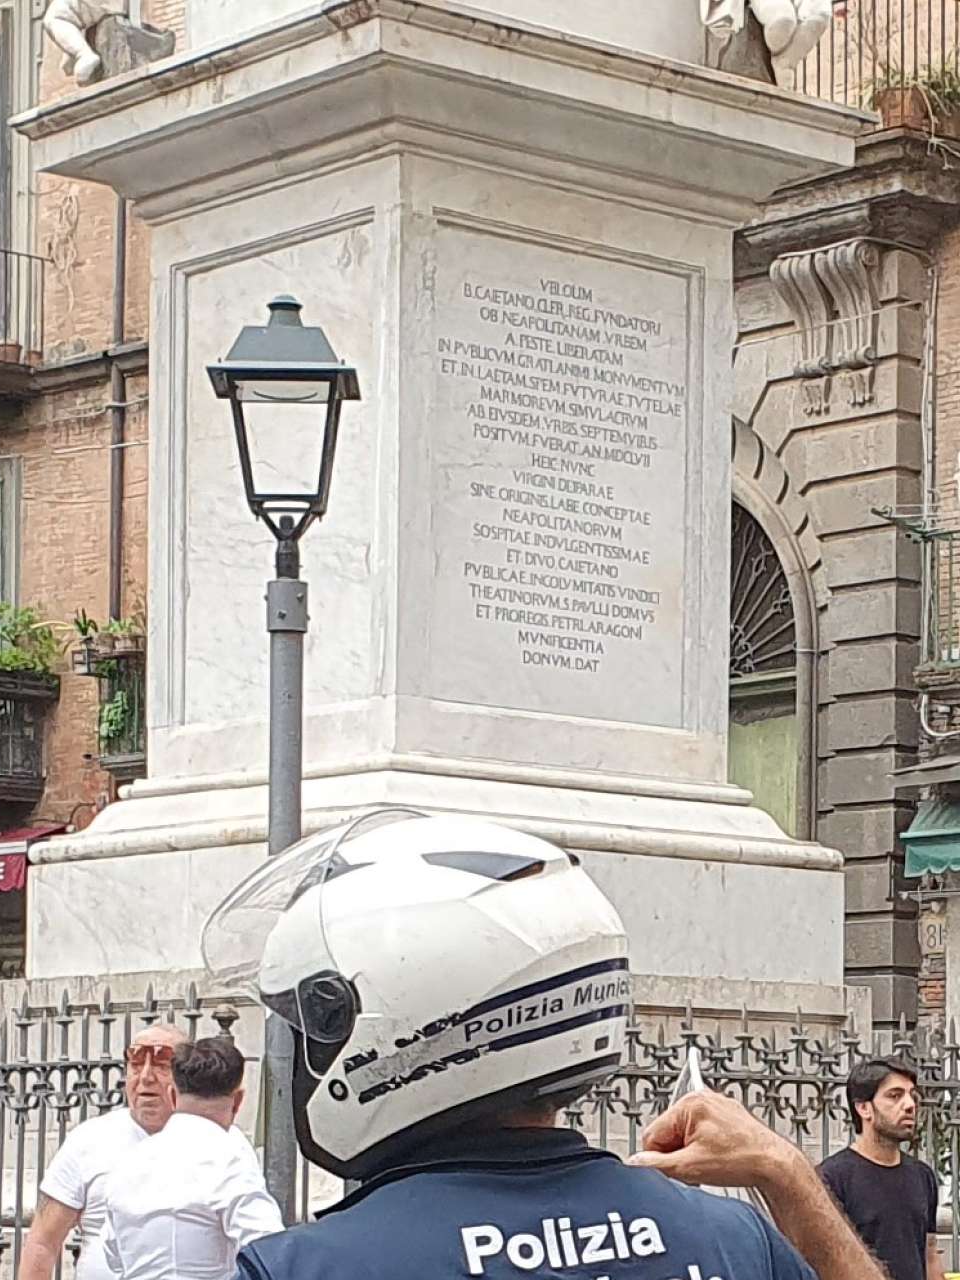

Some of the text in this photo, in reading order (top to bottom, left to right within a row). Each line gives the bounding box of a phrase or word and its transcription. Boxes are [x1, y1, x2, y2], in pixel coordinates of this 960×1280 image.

[479, 305, 497, 323] OB
[502, 507, 622, 541] NEAPOLITANORVM
[575, 656, 600, 674] DAT
[464, 997, 564, 1042] Polizia
[461, 1212, 667, 1275] Polizia
